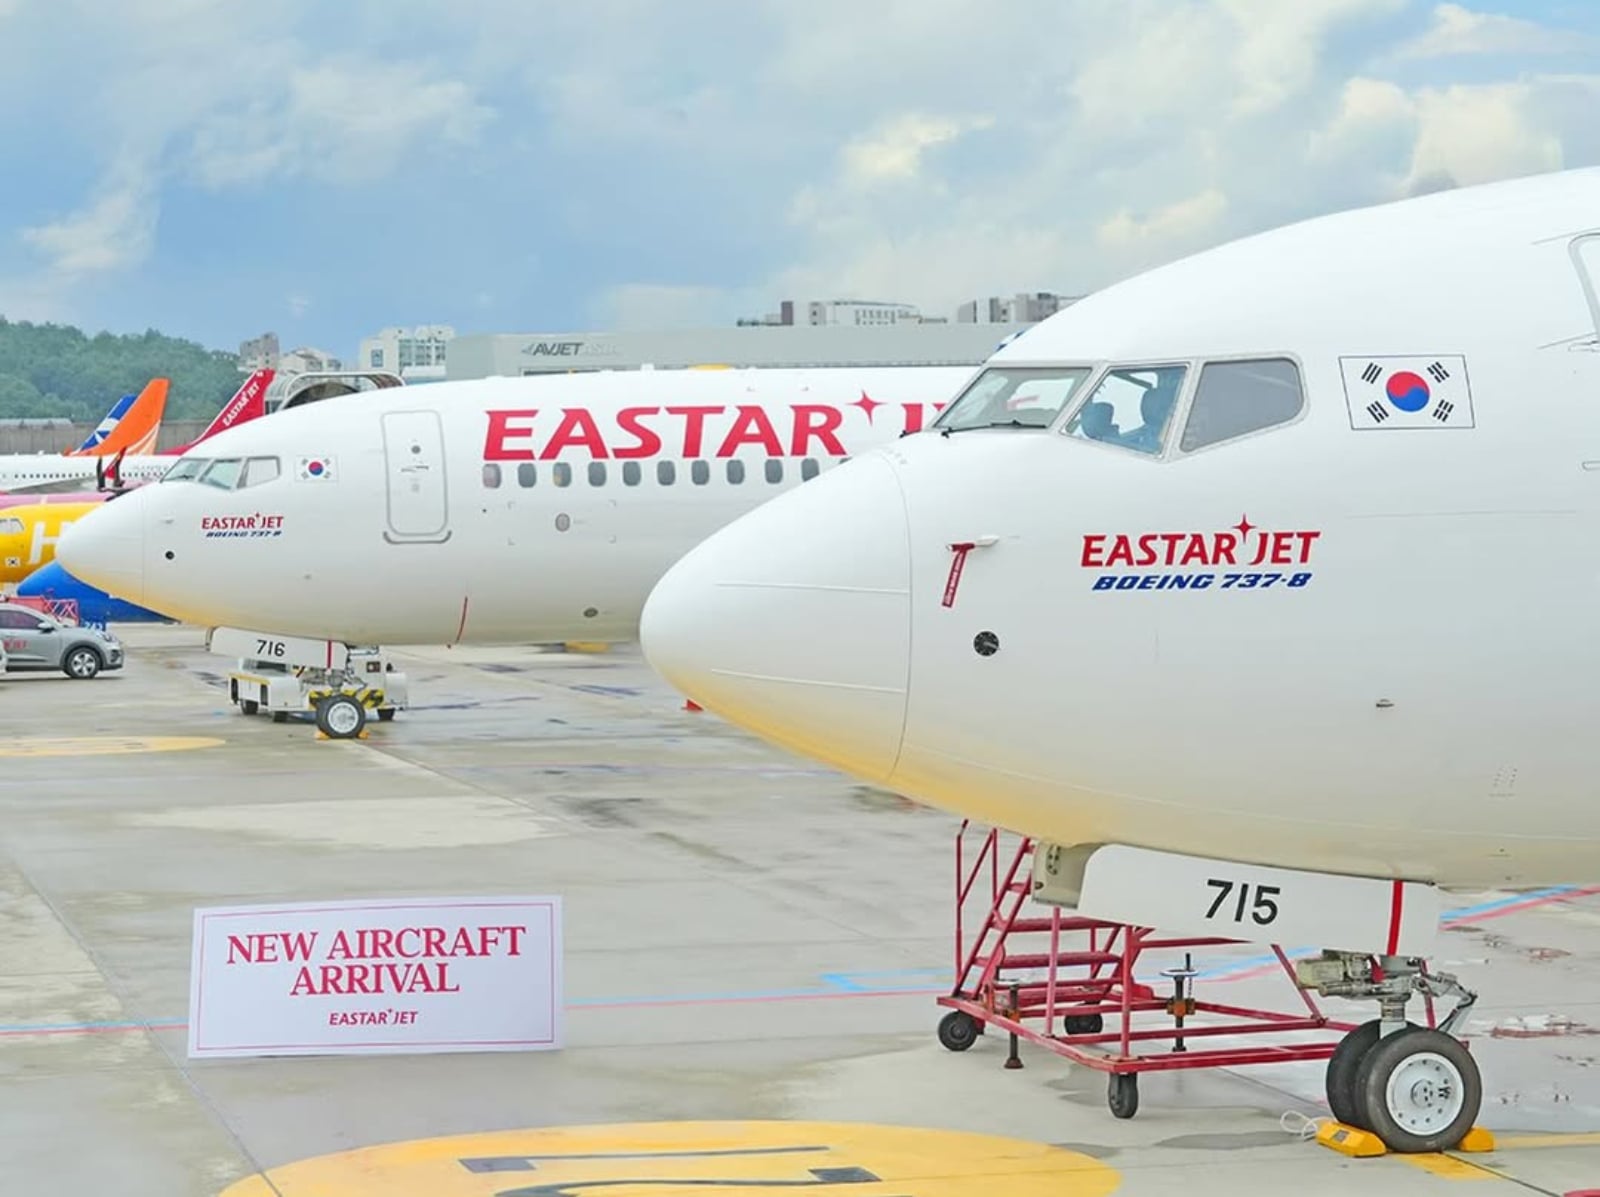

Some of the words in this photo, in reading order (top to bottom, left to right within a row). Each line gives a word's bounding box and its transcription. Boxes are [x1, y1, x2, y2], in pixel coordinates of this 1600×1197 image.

[533, 342, 584, 356] AVJET
[483, 404, 848, 461] EASTAR
[201, 517, 256, 530] EASTAR
[260, 516, 284, 529] JET
[1081, 533, 1238, 568] EASTAR
[1248, 531, 1321, 566] JET
[1092, 574, 1215, 591] BOEING
[1221, 572, 1313, 589] 737-8
[257, 639, 286, 657] 716
[1206, 878, 1280, 925] 715
[226, 932, 318, 964] NEW
[327, 926, 527, 960] AIRCRAFT
[289, 963, 460, 996] ARRIVAL
[329, 1012, 388, 1026] EASTAR
[392, 1011, 418, 1025] JET
